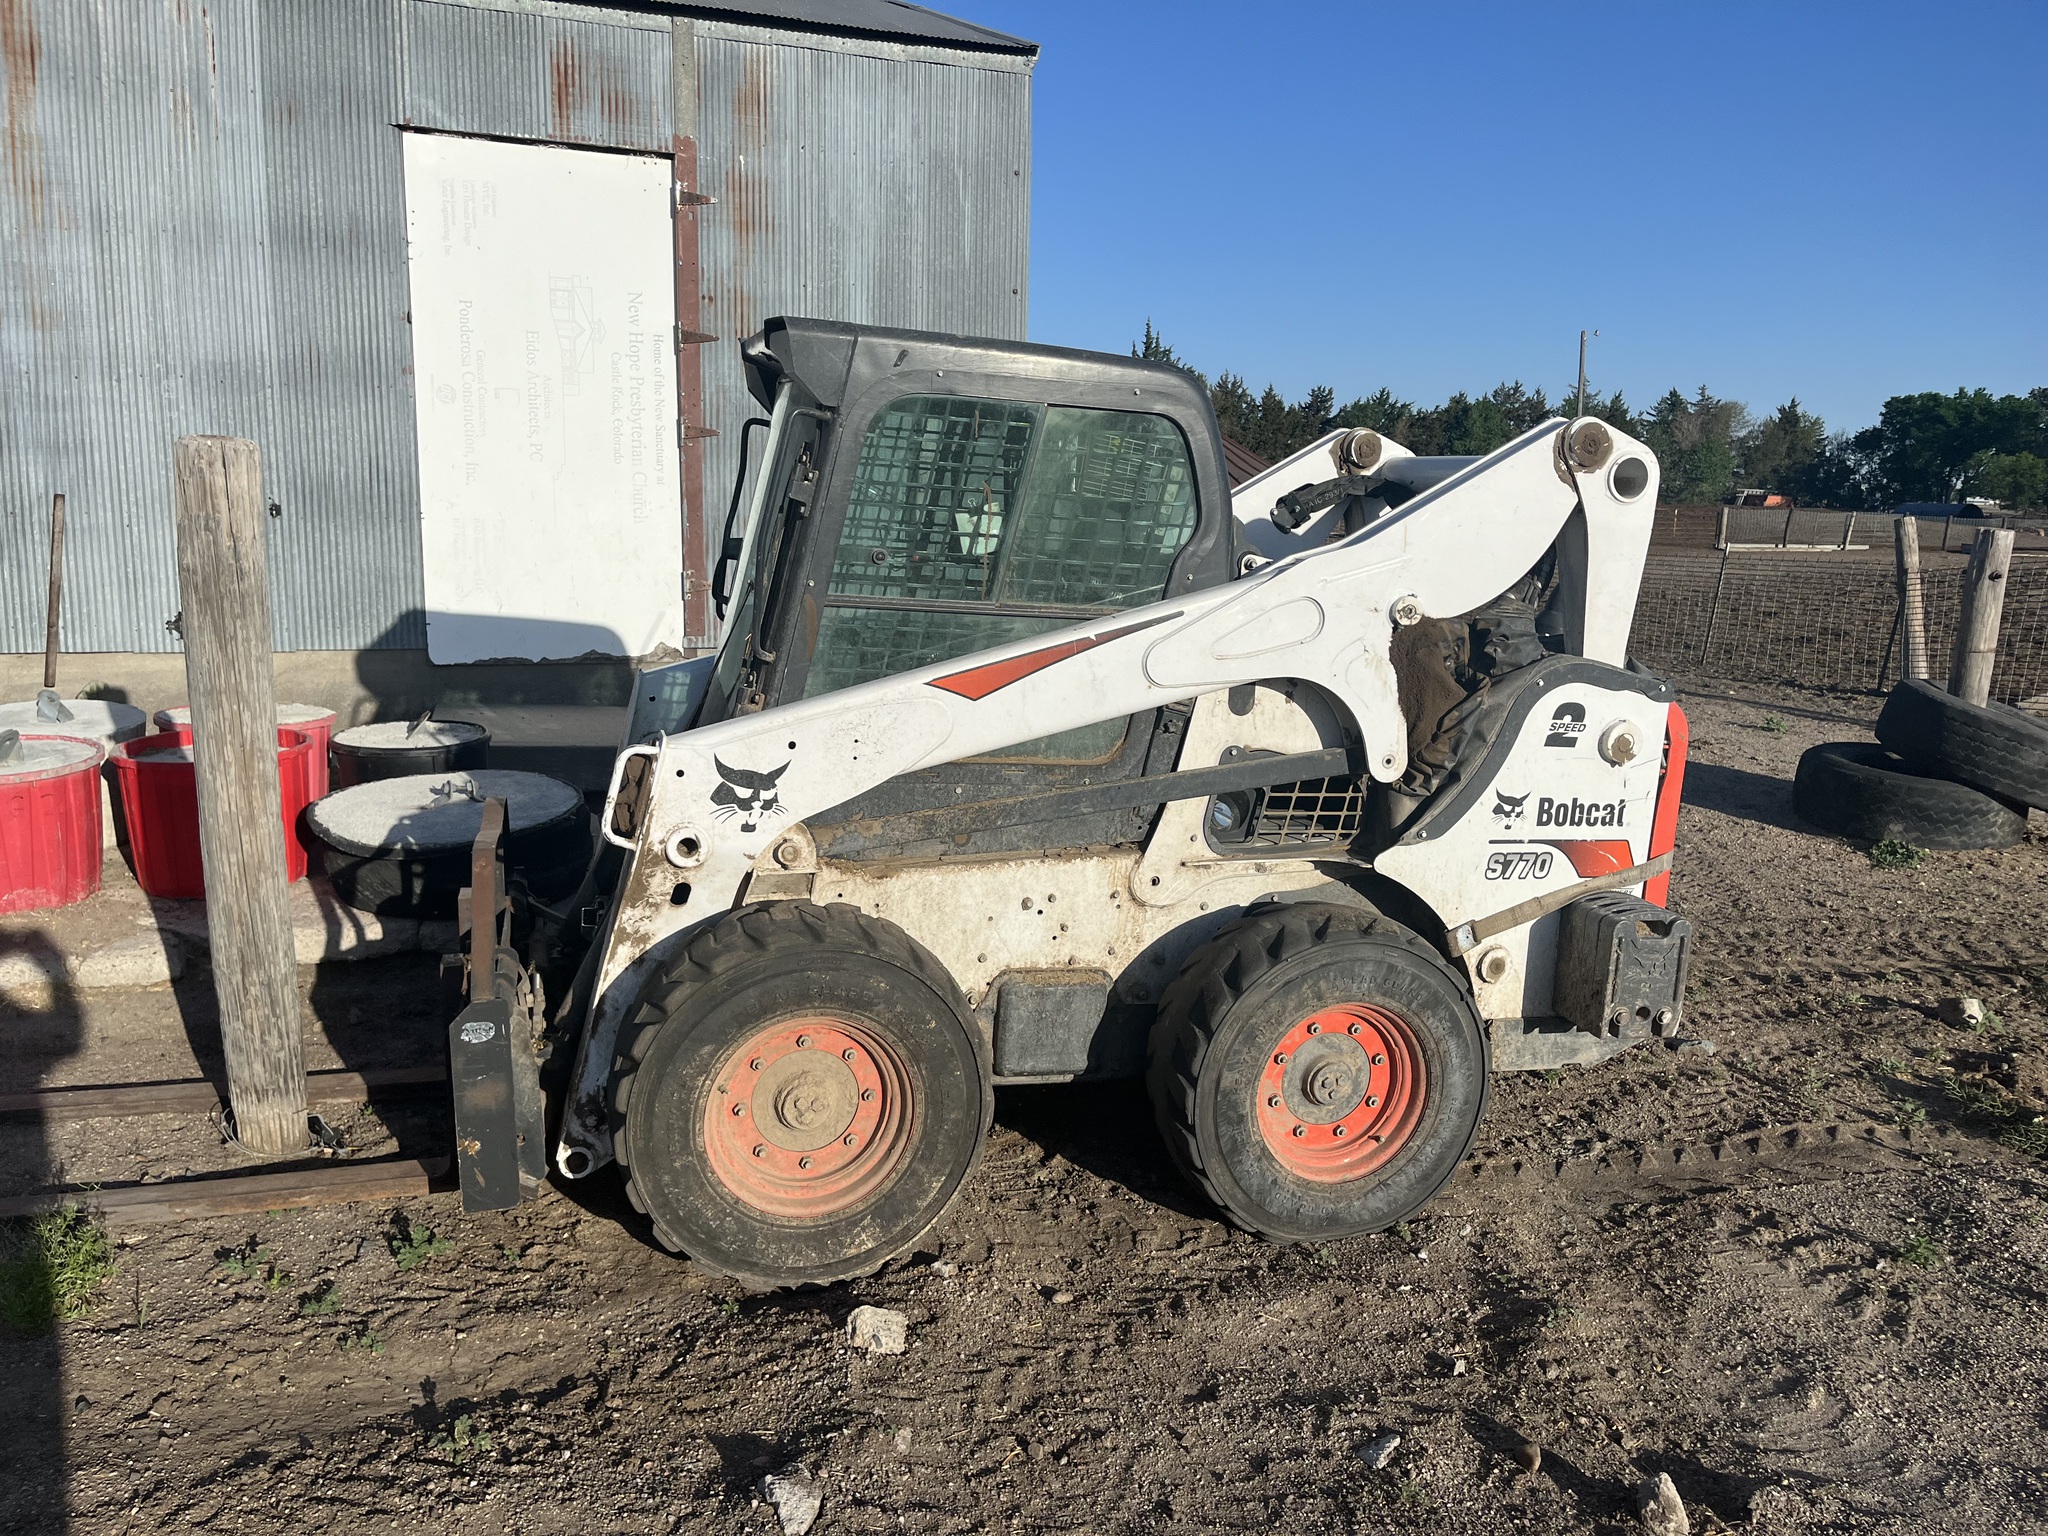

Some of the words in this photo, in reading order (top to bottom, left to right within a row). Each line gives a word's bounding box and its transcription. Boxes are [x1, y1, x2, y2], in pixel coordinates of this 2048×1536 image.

[627, 291, 643, 326] New
[458, 299, 474, 367] Ponderosa
[525, 329, 540, 366] Eidos
[653, 334, 664, 364] Home
[476, 350, 486, 384] General
[610, 352, 622, 383] Castle
[625, 331, 644, 371] Hope
[653, 367, 665, 379] of
[654, 380, 664, 395] the
[461, 371, 478, 457] Construction,
[477, 387, 488, 437] Contractors
[526, 370, 541, 438] Architects,
[543, 375, 553, 419] Architects
[611, 386, 623, 415] Rock,
[654, 398, 665, 421] New
[627, 376, 647, 466] Presbyterian
[529, 443, 543, 462] PC
[613, 418, 624, 464] Colorado
[653, 424, 665, 473] Sanctuary
[465, 462, 479, 486] Inc.
[656, 476, 665, 485] at
[632, 471, 648, 523] Church
[1544, 702, 1586, 748] 2
[1549, 722, 1587, 733] SPEED
[1536, 797, 1626, 827] Bobcat
[1485, 852, 1554, 880] S770
